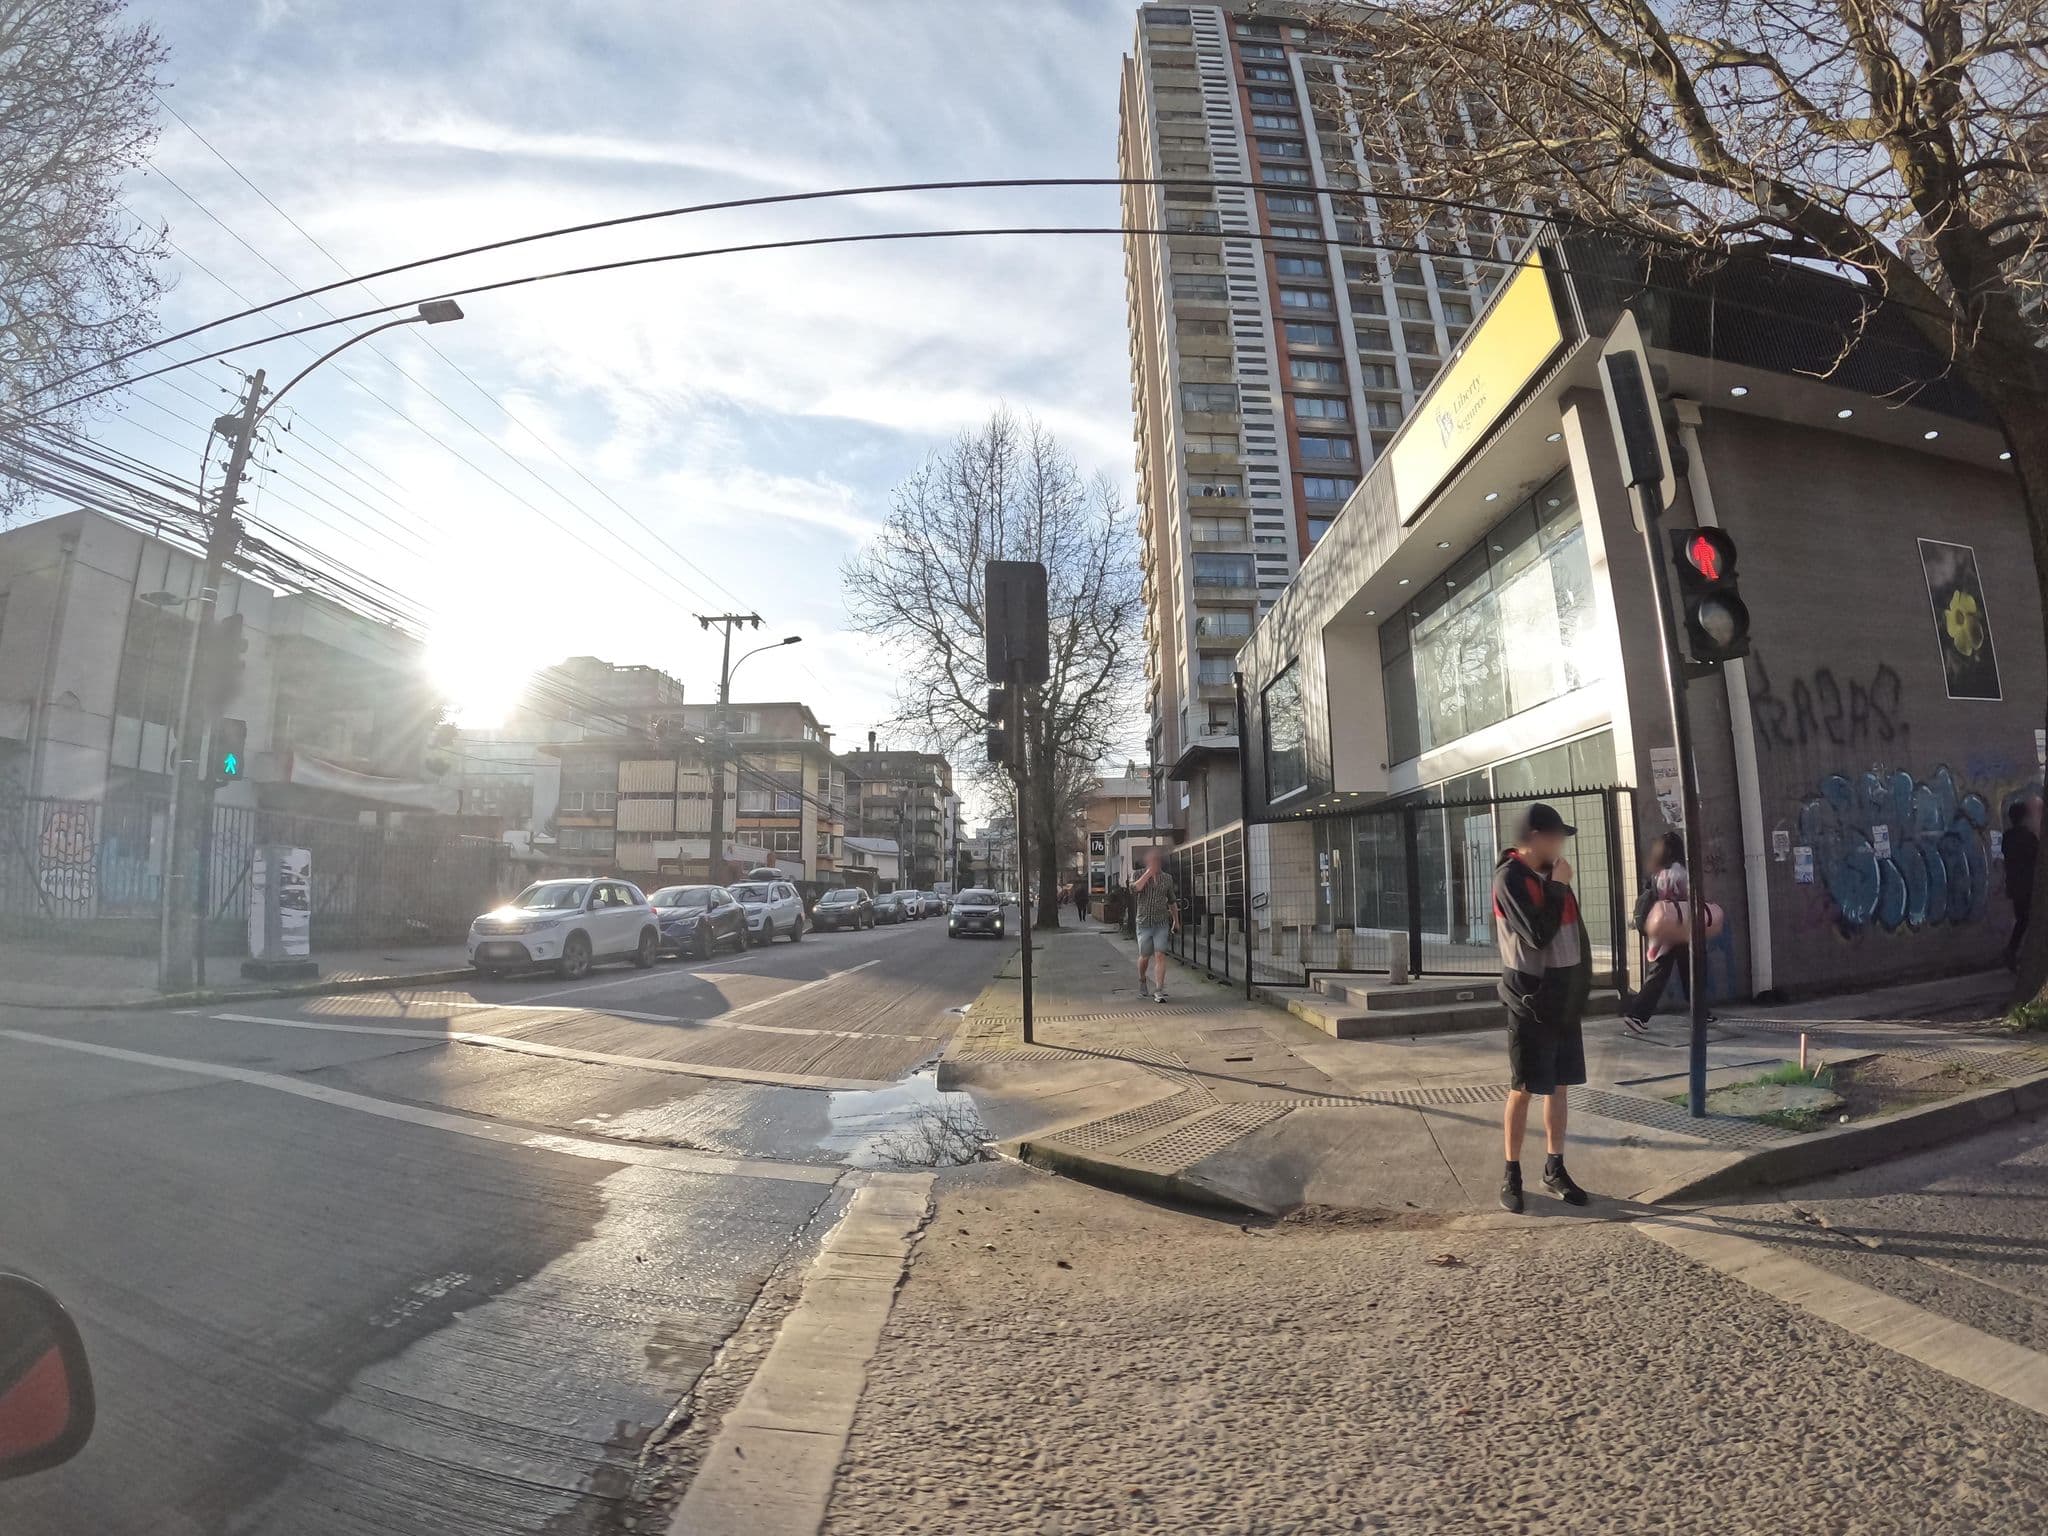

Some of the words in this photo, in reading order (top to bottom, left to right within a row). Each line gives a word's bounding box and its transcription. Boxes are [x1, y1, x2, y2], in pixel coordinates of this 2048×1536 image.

[1452, 374, 1482, 415] Liberty
[1457, 394, 1487, 432] Seguros
[1091, 840, 1104, 851] 176
